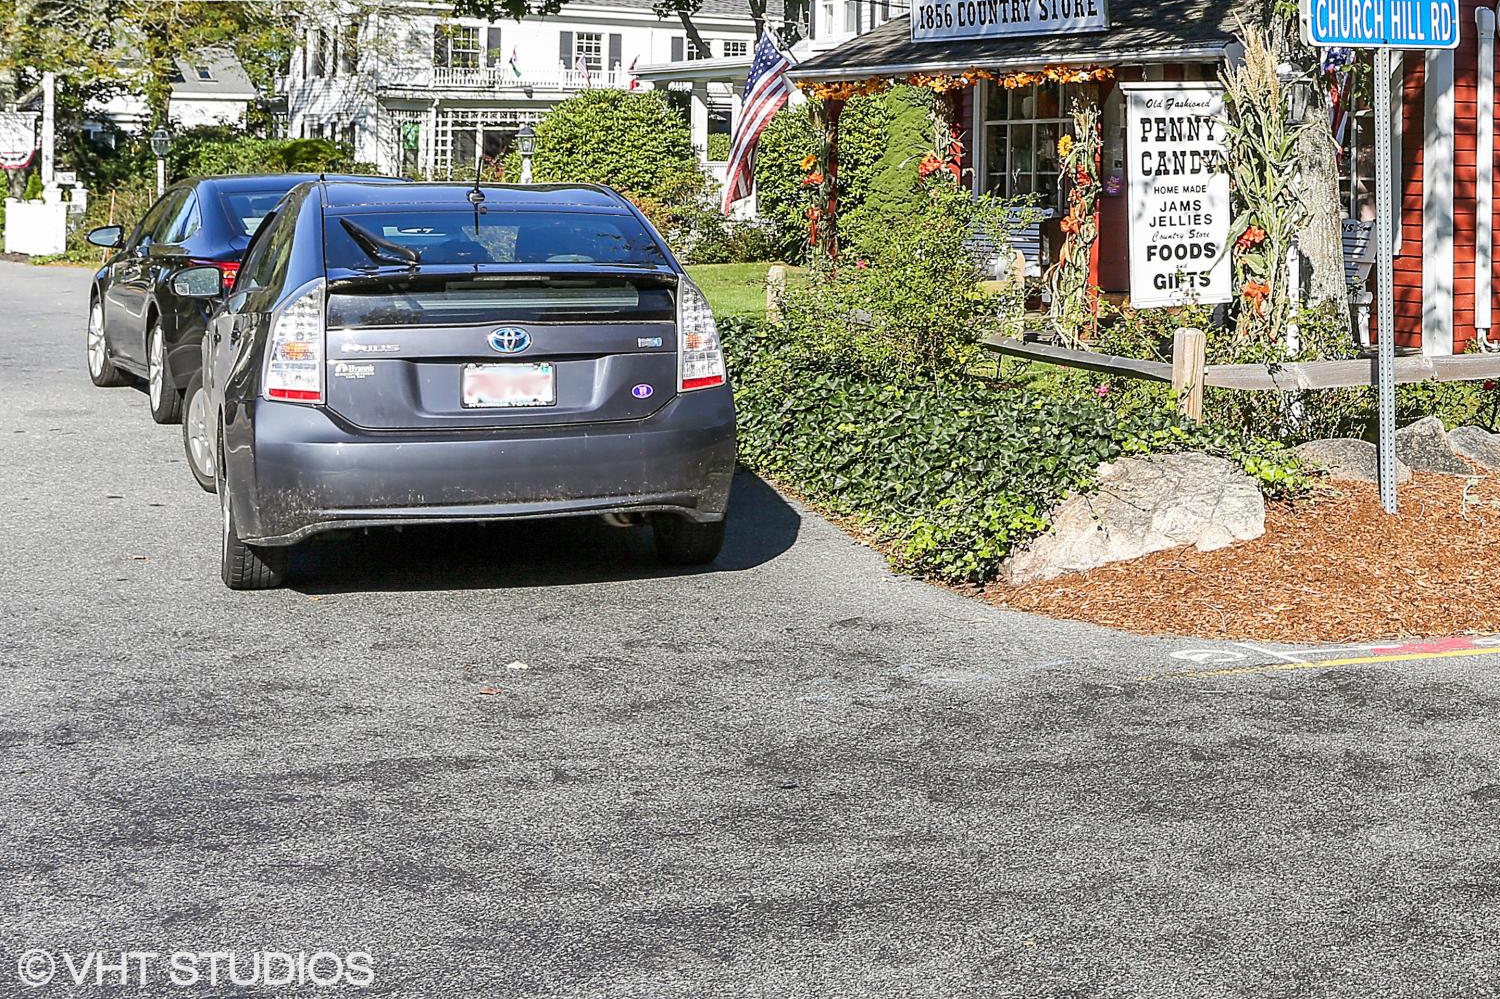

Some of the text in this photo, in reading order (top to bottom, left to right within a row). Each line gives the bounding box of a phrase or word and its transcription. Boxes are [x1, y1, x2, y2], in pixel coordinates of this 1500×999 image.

[919, 3, 952, 29] 1856
[1390, 0, 1425, 40] HILL
[1430, 1, 1451, 41] RD
[1145, 97, 1212, 110] Old Fashioned
[1140, 116, 1217, 142] PENNY
[1142, 150, 1218, 176] CANDY
[1153, 184, 1207, 195] HOME MADE
[1159, 199, 1202, 213] JAMS
[1149, 213, 1213, 228] JELLIES
[1152, 228, 1211, 243] Country Store
[1146, 242, 1216, 261] FOODS
